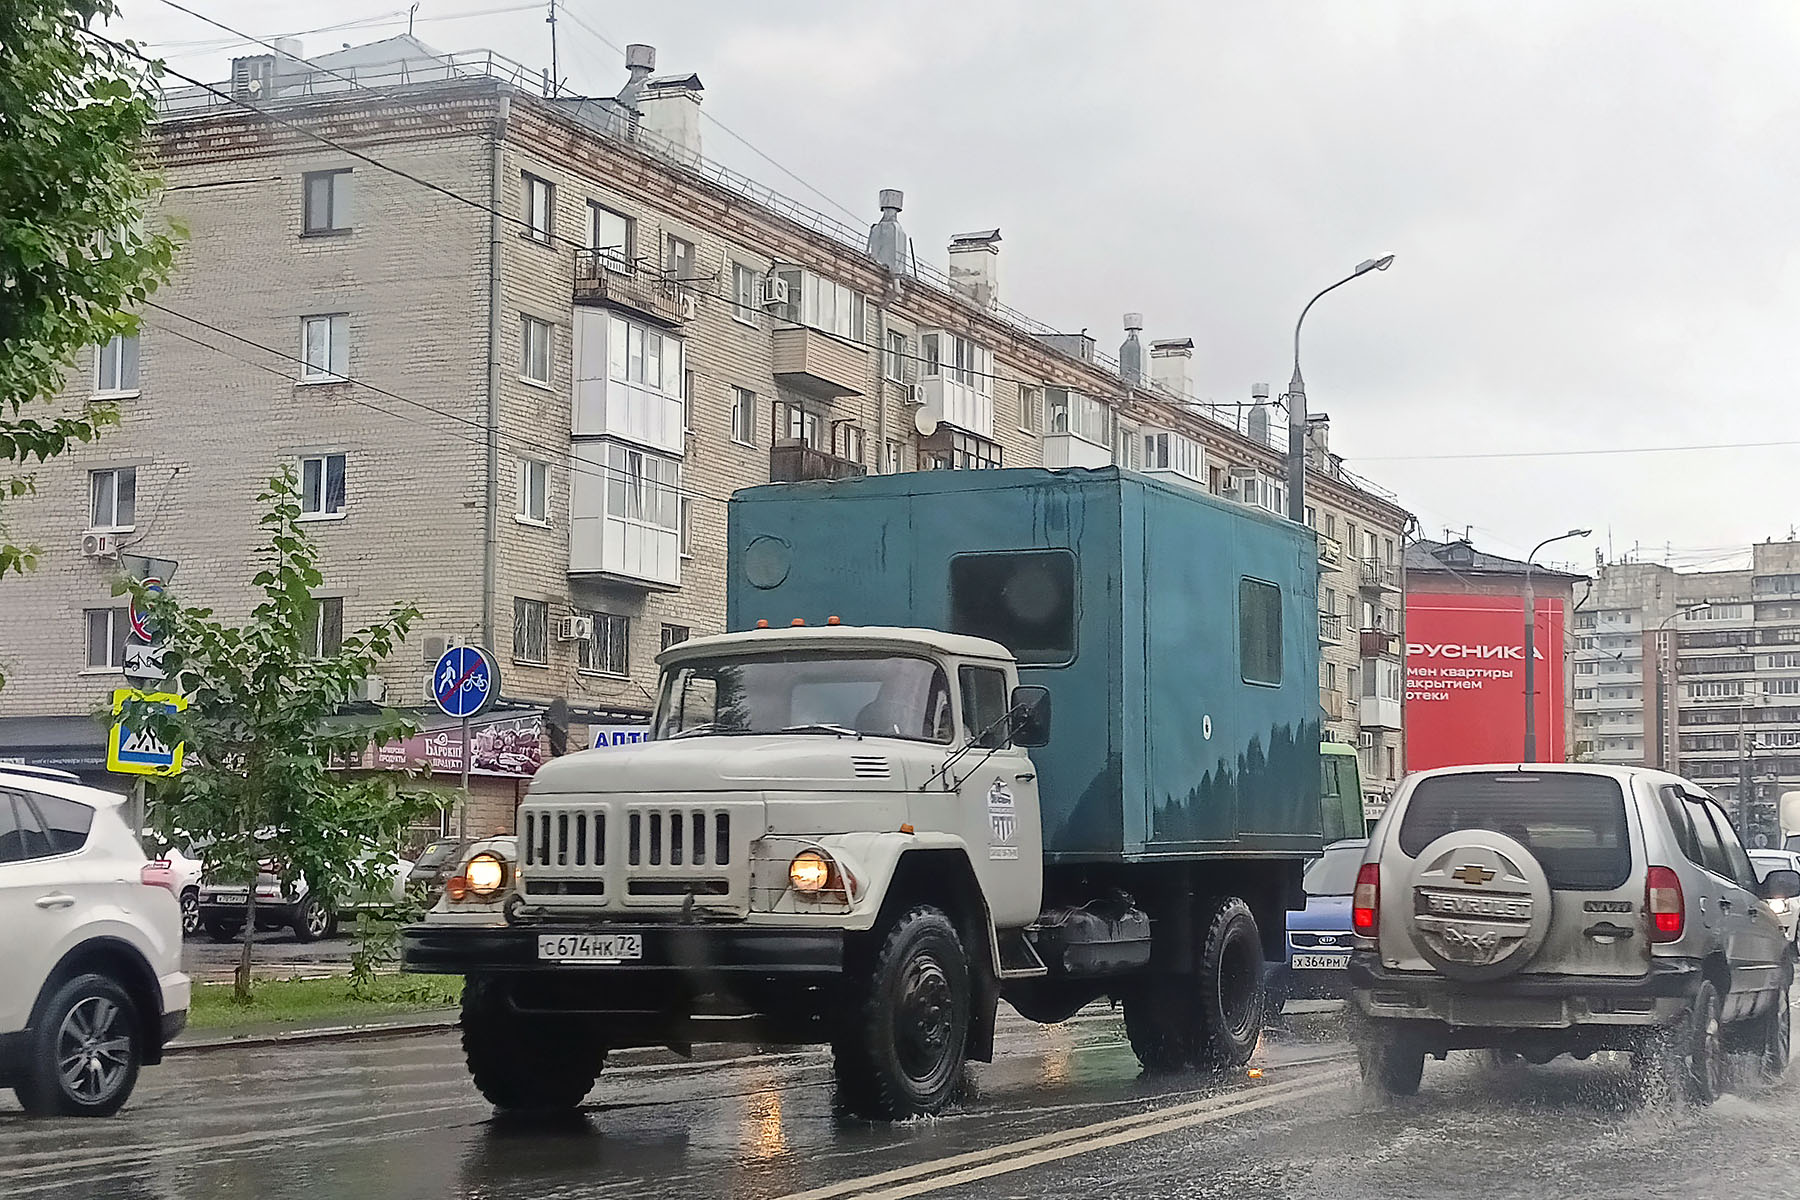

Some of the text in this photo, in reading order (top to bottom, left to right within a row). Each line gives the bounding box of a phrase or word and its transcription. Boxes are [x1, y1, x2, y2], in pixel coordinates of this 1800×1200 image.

[1406, 667, 1514, 680] мен квартиры
[1406, 679, 1482, 690] акрытием
[1405, 691, 1449, 701] отеки
